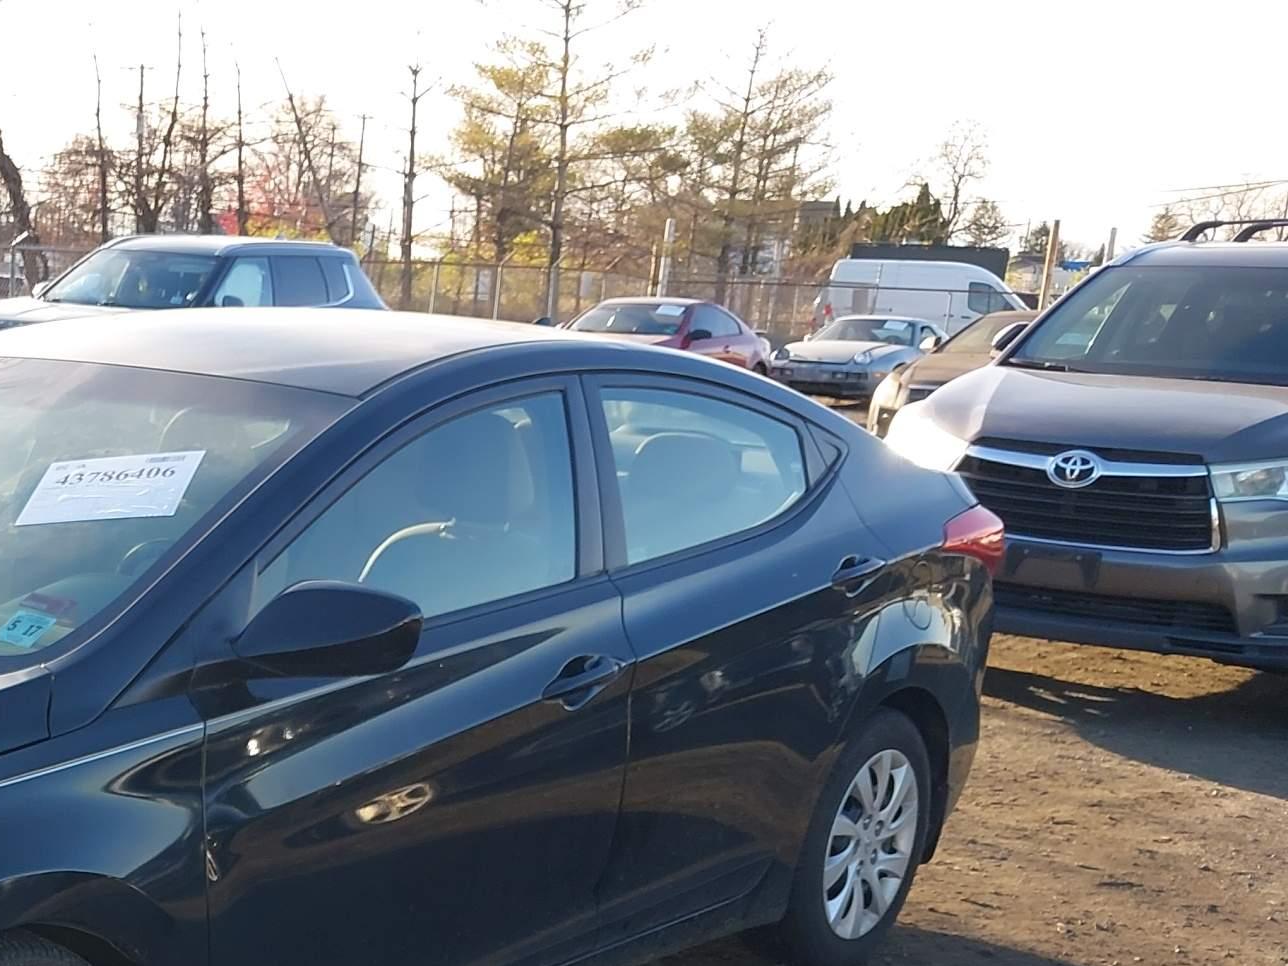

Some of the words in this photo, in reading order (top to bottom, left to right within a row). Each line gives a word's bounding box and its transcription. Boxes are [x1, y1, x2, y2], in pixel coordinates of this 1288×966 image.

[55, 466, 176, 486] 43786406
[7, 620, 21, 631] 5
[22, 624, 43, 637] 17
